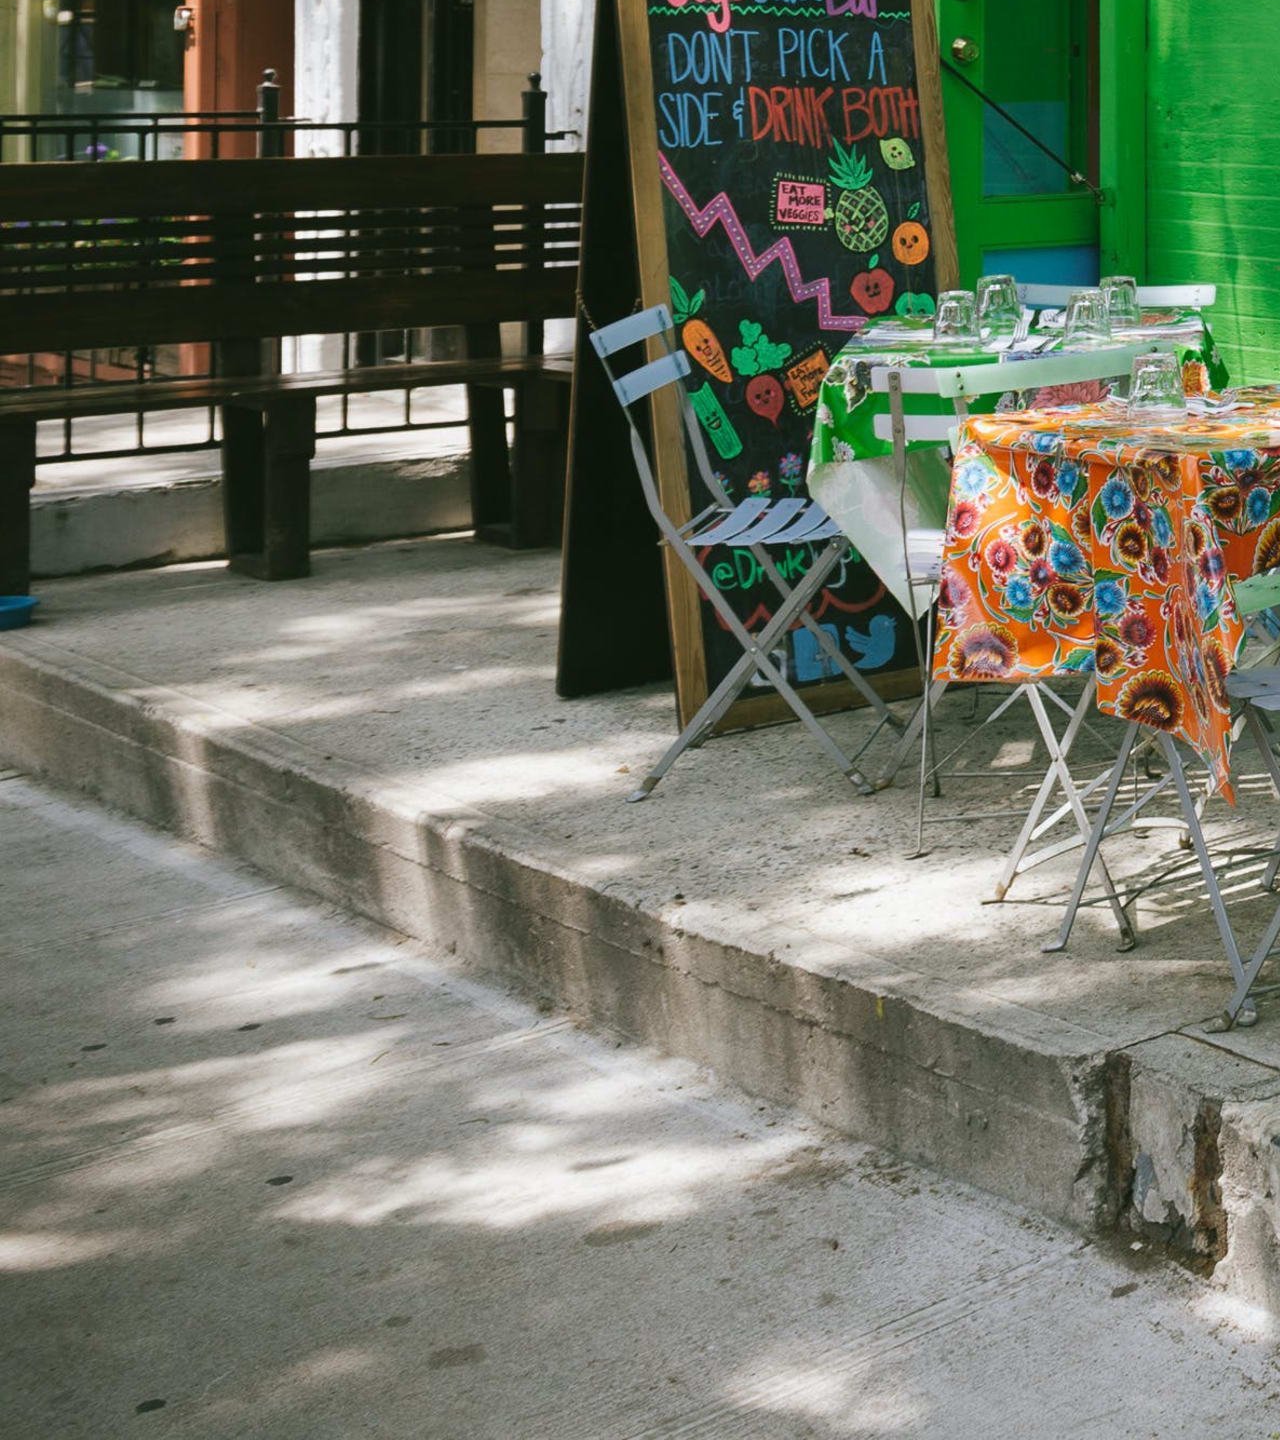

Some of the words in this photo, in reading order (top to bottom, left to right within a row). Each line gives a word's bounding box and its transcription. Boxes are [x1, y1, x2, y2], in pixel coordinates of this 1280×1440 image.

[668, 28, 759, 85] DON'T
[778, 28, 850, 81] PICK
[868, 31, 887, 85] A
[659, 92, 723, 148] SIDE
[749, 86, 834, 149] DRINK
[842, 86, 919, 145] BOTH
[781, 184, 806, 195] EAT
[788, 195, 821, 207] MORE
[779, 208, 819, 222] VEGGIES
